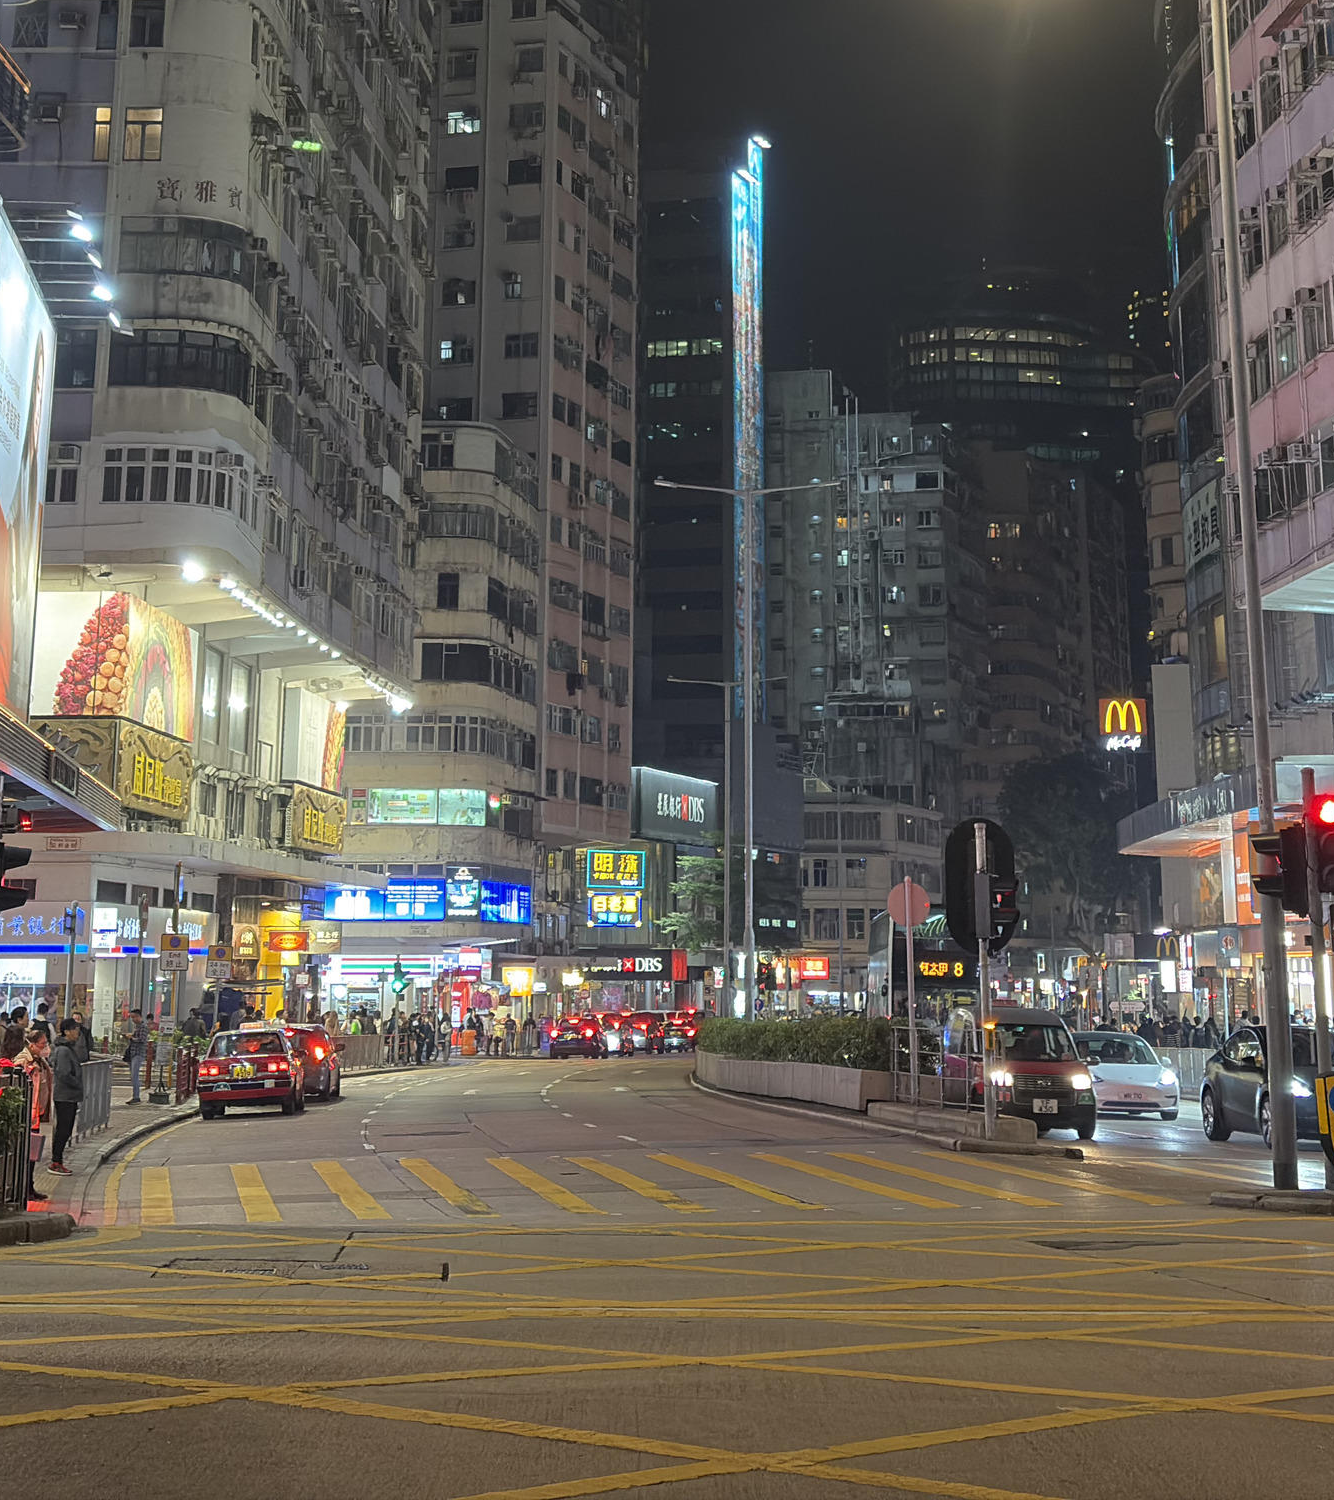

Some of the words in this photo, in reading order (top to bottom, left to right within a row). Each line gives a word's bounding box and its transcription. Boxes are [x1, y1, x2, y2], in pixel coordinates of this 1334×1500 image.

[688, 796, 705, 824] DBS
[634, 957, 663, 973] DBS
[953, 962, 964, 978] 8
